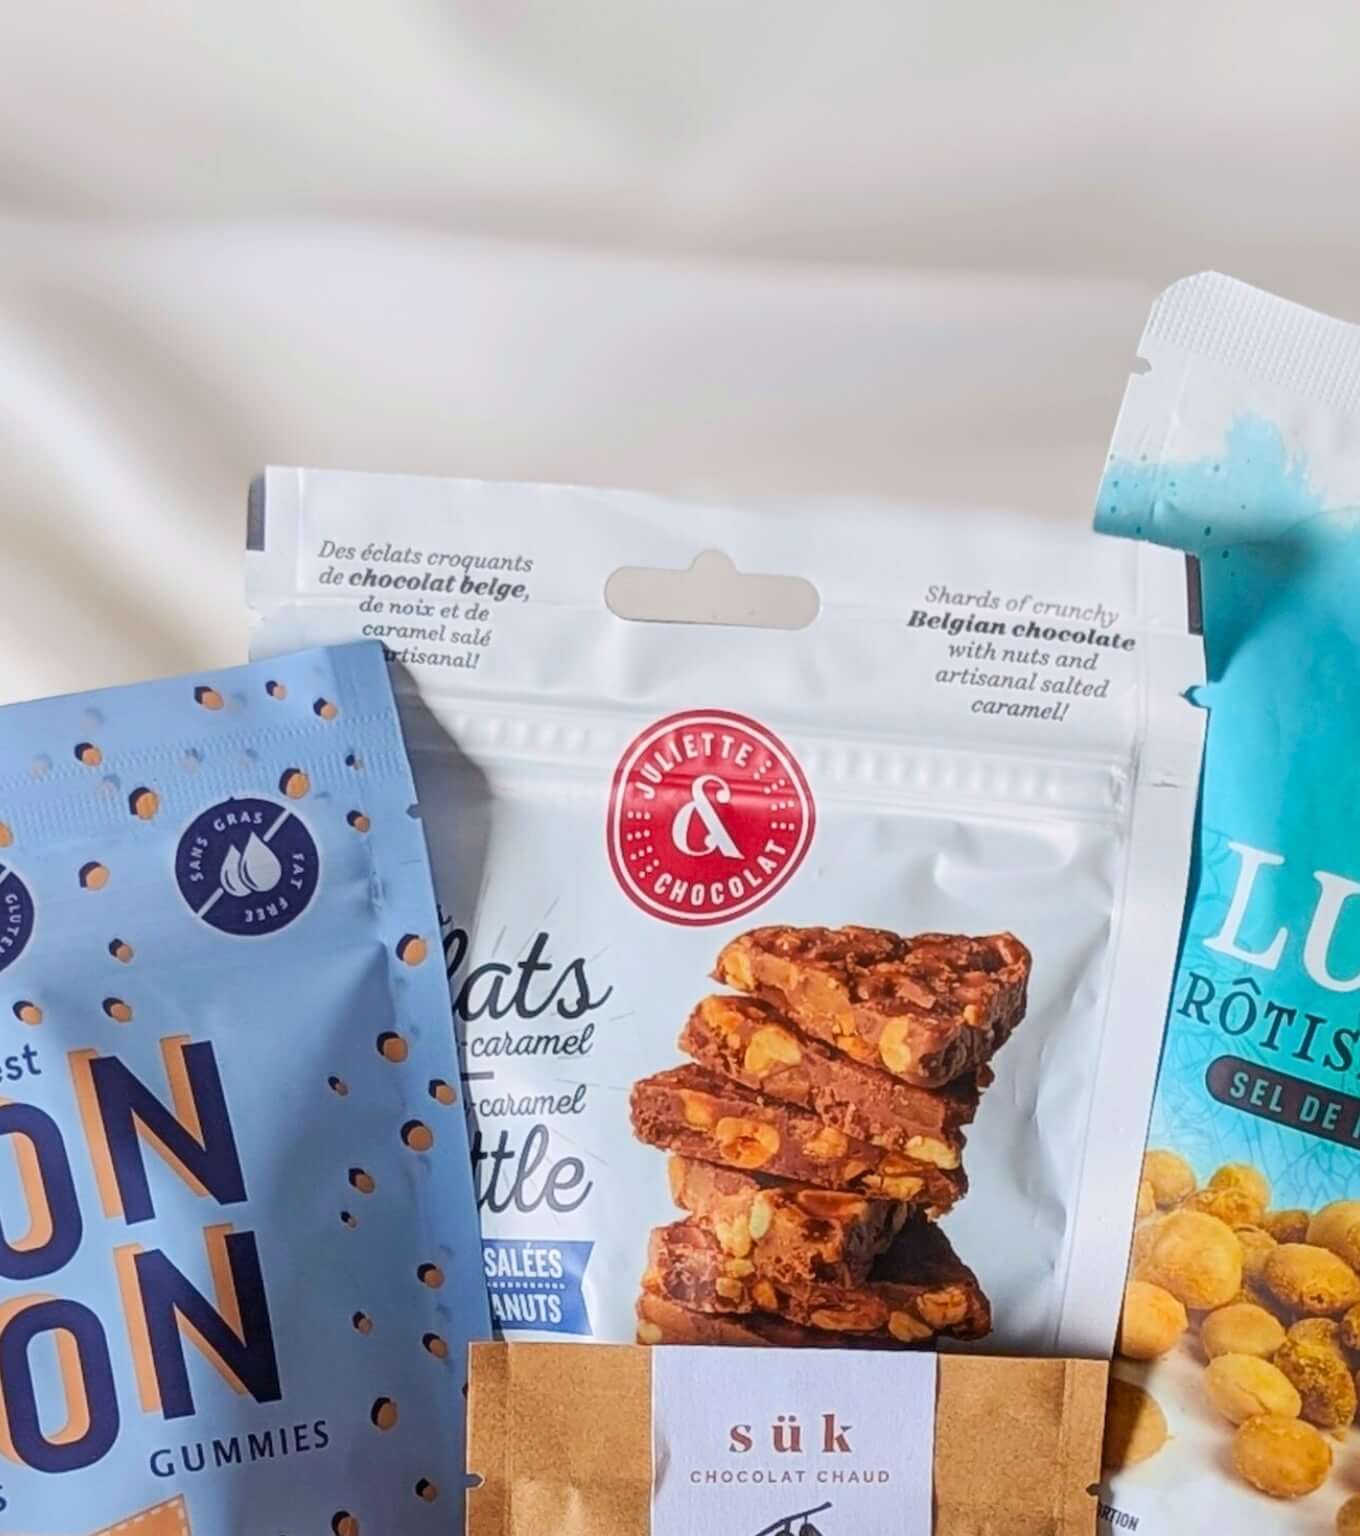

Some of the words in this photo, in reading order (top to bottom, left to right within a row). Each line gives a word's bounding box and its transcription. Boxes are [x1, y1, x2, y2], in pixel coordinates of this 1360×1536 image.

[318, 540, 356, 562] Des
[361, 542, 423, 565] éclats
[427, 550, 533, 574] croquants
[319, 568, 344, 586] de
[349, 569, 456, 594] chocolat
[460, 573, 530, 602] belge,
[359, 595, 384, 613] de
[390, 598, 435, 617] noix
[440, 603, 460, 619] et
[464, 603, 490, 621] de
[925, 585, 1001, 610] Shards
[1006, 594, 1032, 613] of
[1033, 600, 1119, 628] crunchy
[362, 623, 445, 642] caramel
[450, 629, 492, 647] salé
[907, 610, 1006, 636] Belgian
[1011, 621, 1136, 651] chocolate
[948, 641, 996, 661] with
[1002, 648, 1049, 666] nuts
[1055, 653, 1099, 671] and
[935, 667, 1037, 691] artisanal
[1040, 676, 1110, 698] salted
[971, 698, 1070, 722] caramel!
[635, 732, 753, 800] JULIETTE
[672, 774, 745, 860] &
[190, 837, 208, 882] SANS
[213, 811, 263, 832] GRAS
[291, 853, 305, 889] FAT
[653, 839, 786, 906] CHOCOLAT
[245, 897, 289, 923] FREE
[442, 928, 614, 1022] lats
[1229, 1072, 1284, 1114] SEL
[1299, 1092, 1337, 1132] DE
[471, 1123, 593, 1213] ttle
[483, 1242, 563, 1278] SALÉES
[491, 1293, 562, 1324] ANUTS
[149, 1421, 330, 1479] GUMMIES
[729, 1414, 853, 1453] sük
[690, 1469, 806, 1485] CHOCOLAT
[816, 1469, 891, 1485] CHAUD
